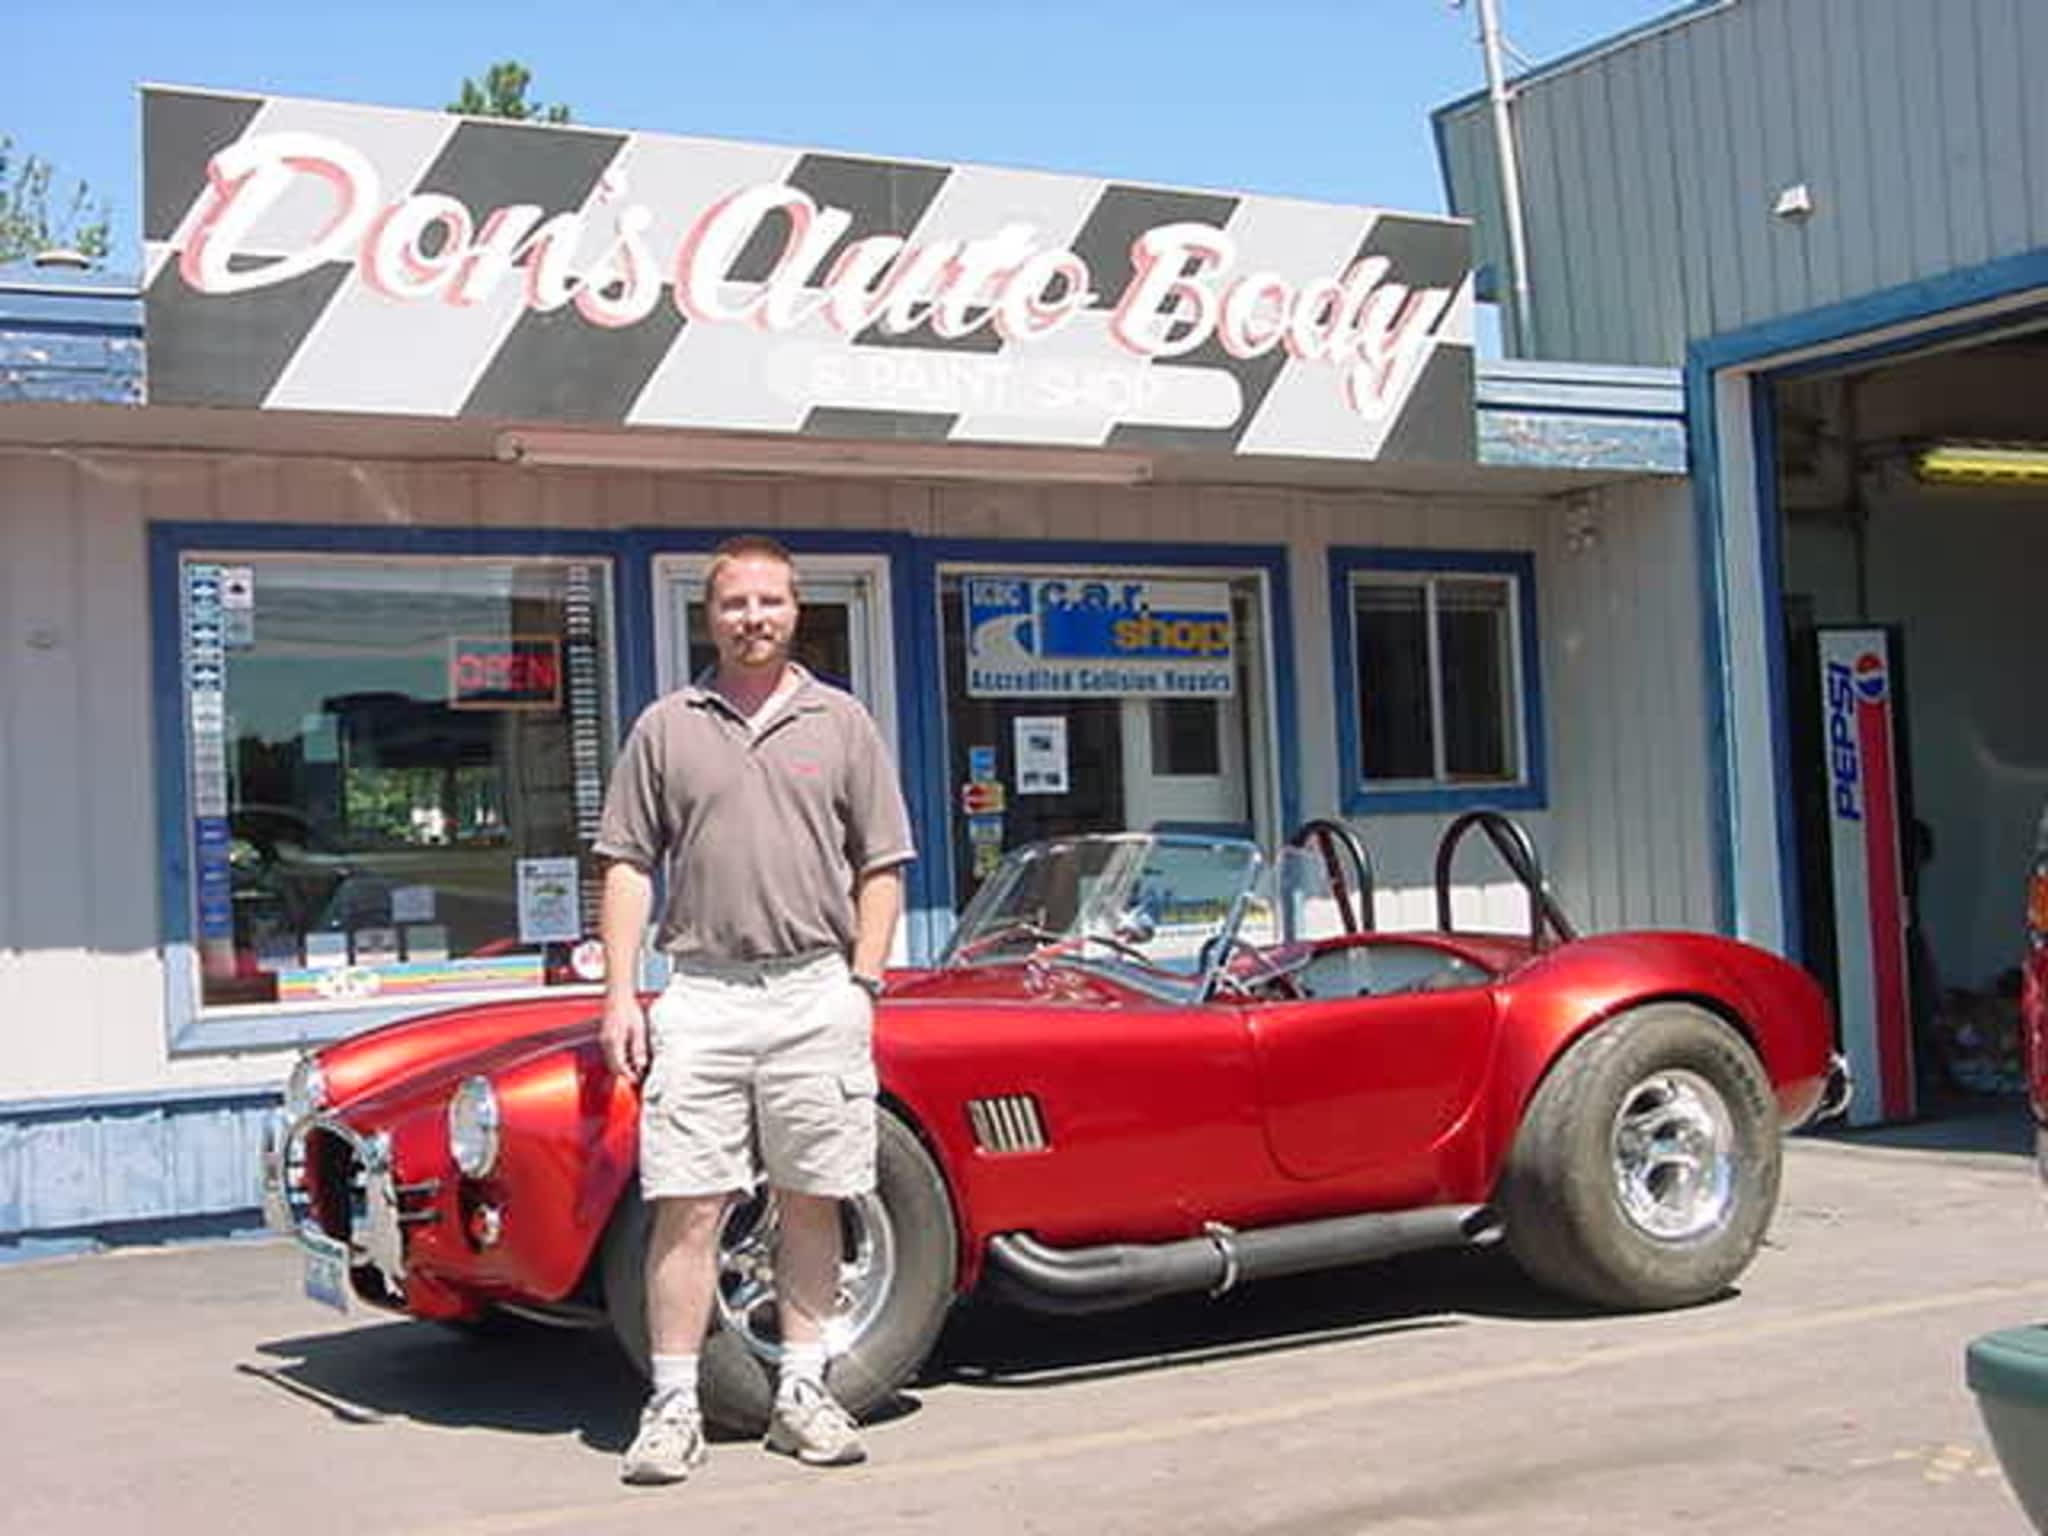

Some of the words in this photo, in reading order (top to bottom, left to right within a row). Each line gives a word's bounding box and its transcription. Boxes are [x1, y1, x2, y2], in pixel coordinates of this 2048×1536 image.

[180, 131, 661, 328] Don's
[673, 182, 1097, 343] Auto
[1108, 221, 1449, 421] Body
[868, 354, 1012, 408] PAINT
[1042, 368, 1162, 414] SHOP
[1112, 617, 1230, 655] shop
[452, 652, 558, 692] OPEN
[1828, 661, 1862, 822] PEPSI
